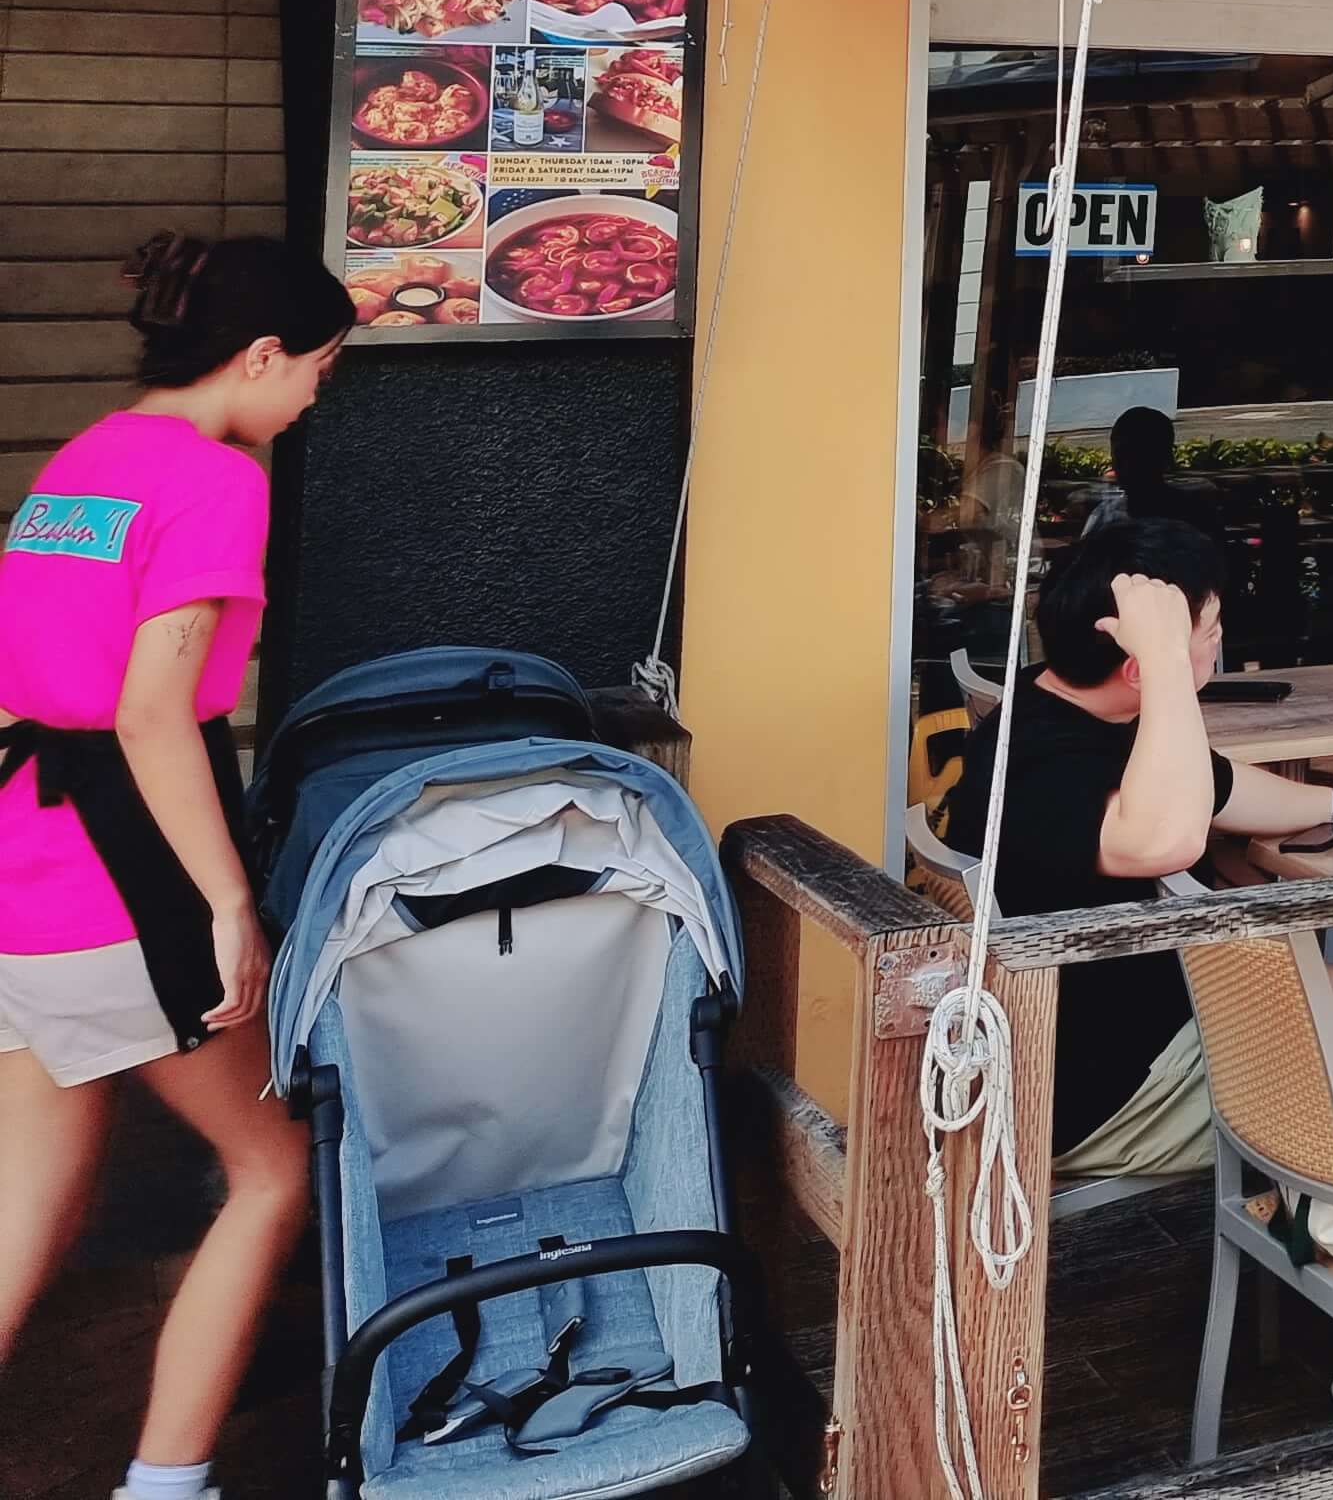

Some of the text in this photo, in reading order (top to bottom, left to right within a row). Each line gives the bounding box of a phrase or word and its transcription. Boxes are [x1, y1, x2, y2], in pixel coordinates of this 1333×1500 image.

[493, 157, 531, 165] SUNDAY
[540, 157, 588, 165] THURSDAY
[589, 157, 613, 165] 10AM
[622, 157, 645, 165] 10PM
[493, 166, 526, 174] FRIDAY
[529, 166, 535, 174] &
[538, 166, 584, 174] SATURDAY
[1024, 191, 1149, 247] OPEN
